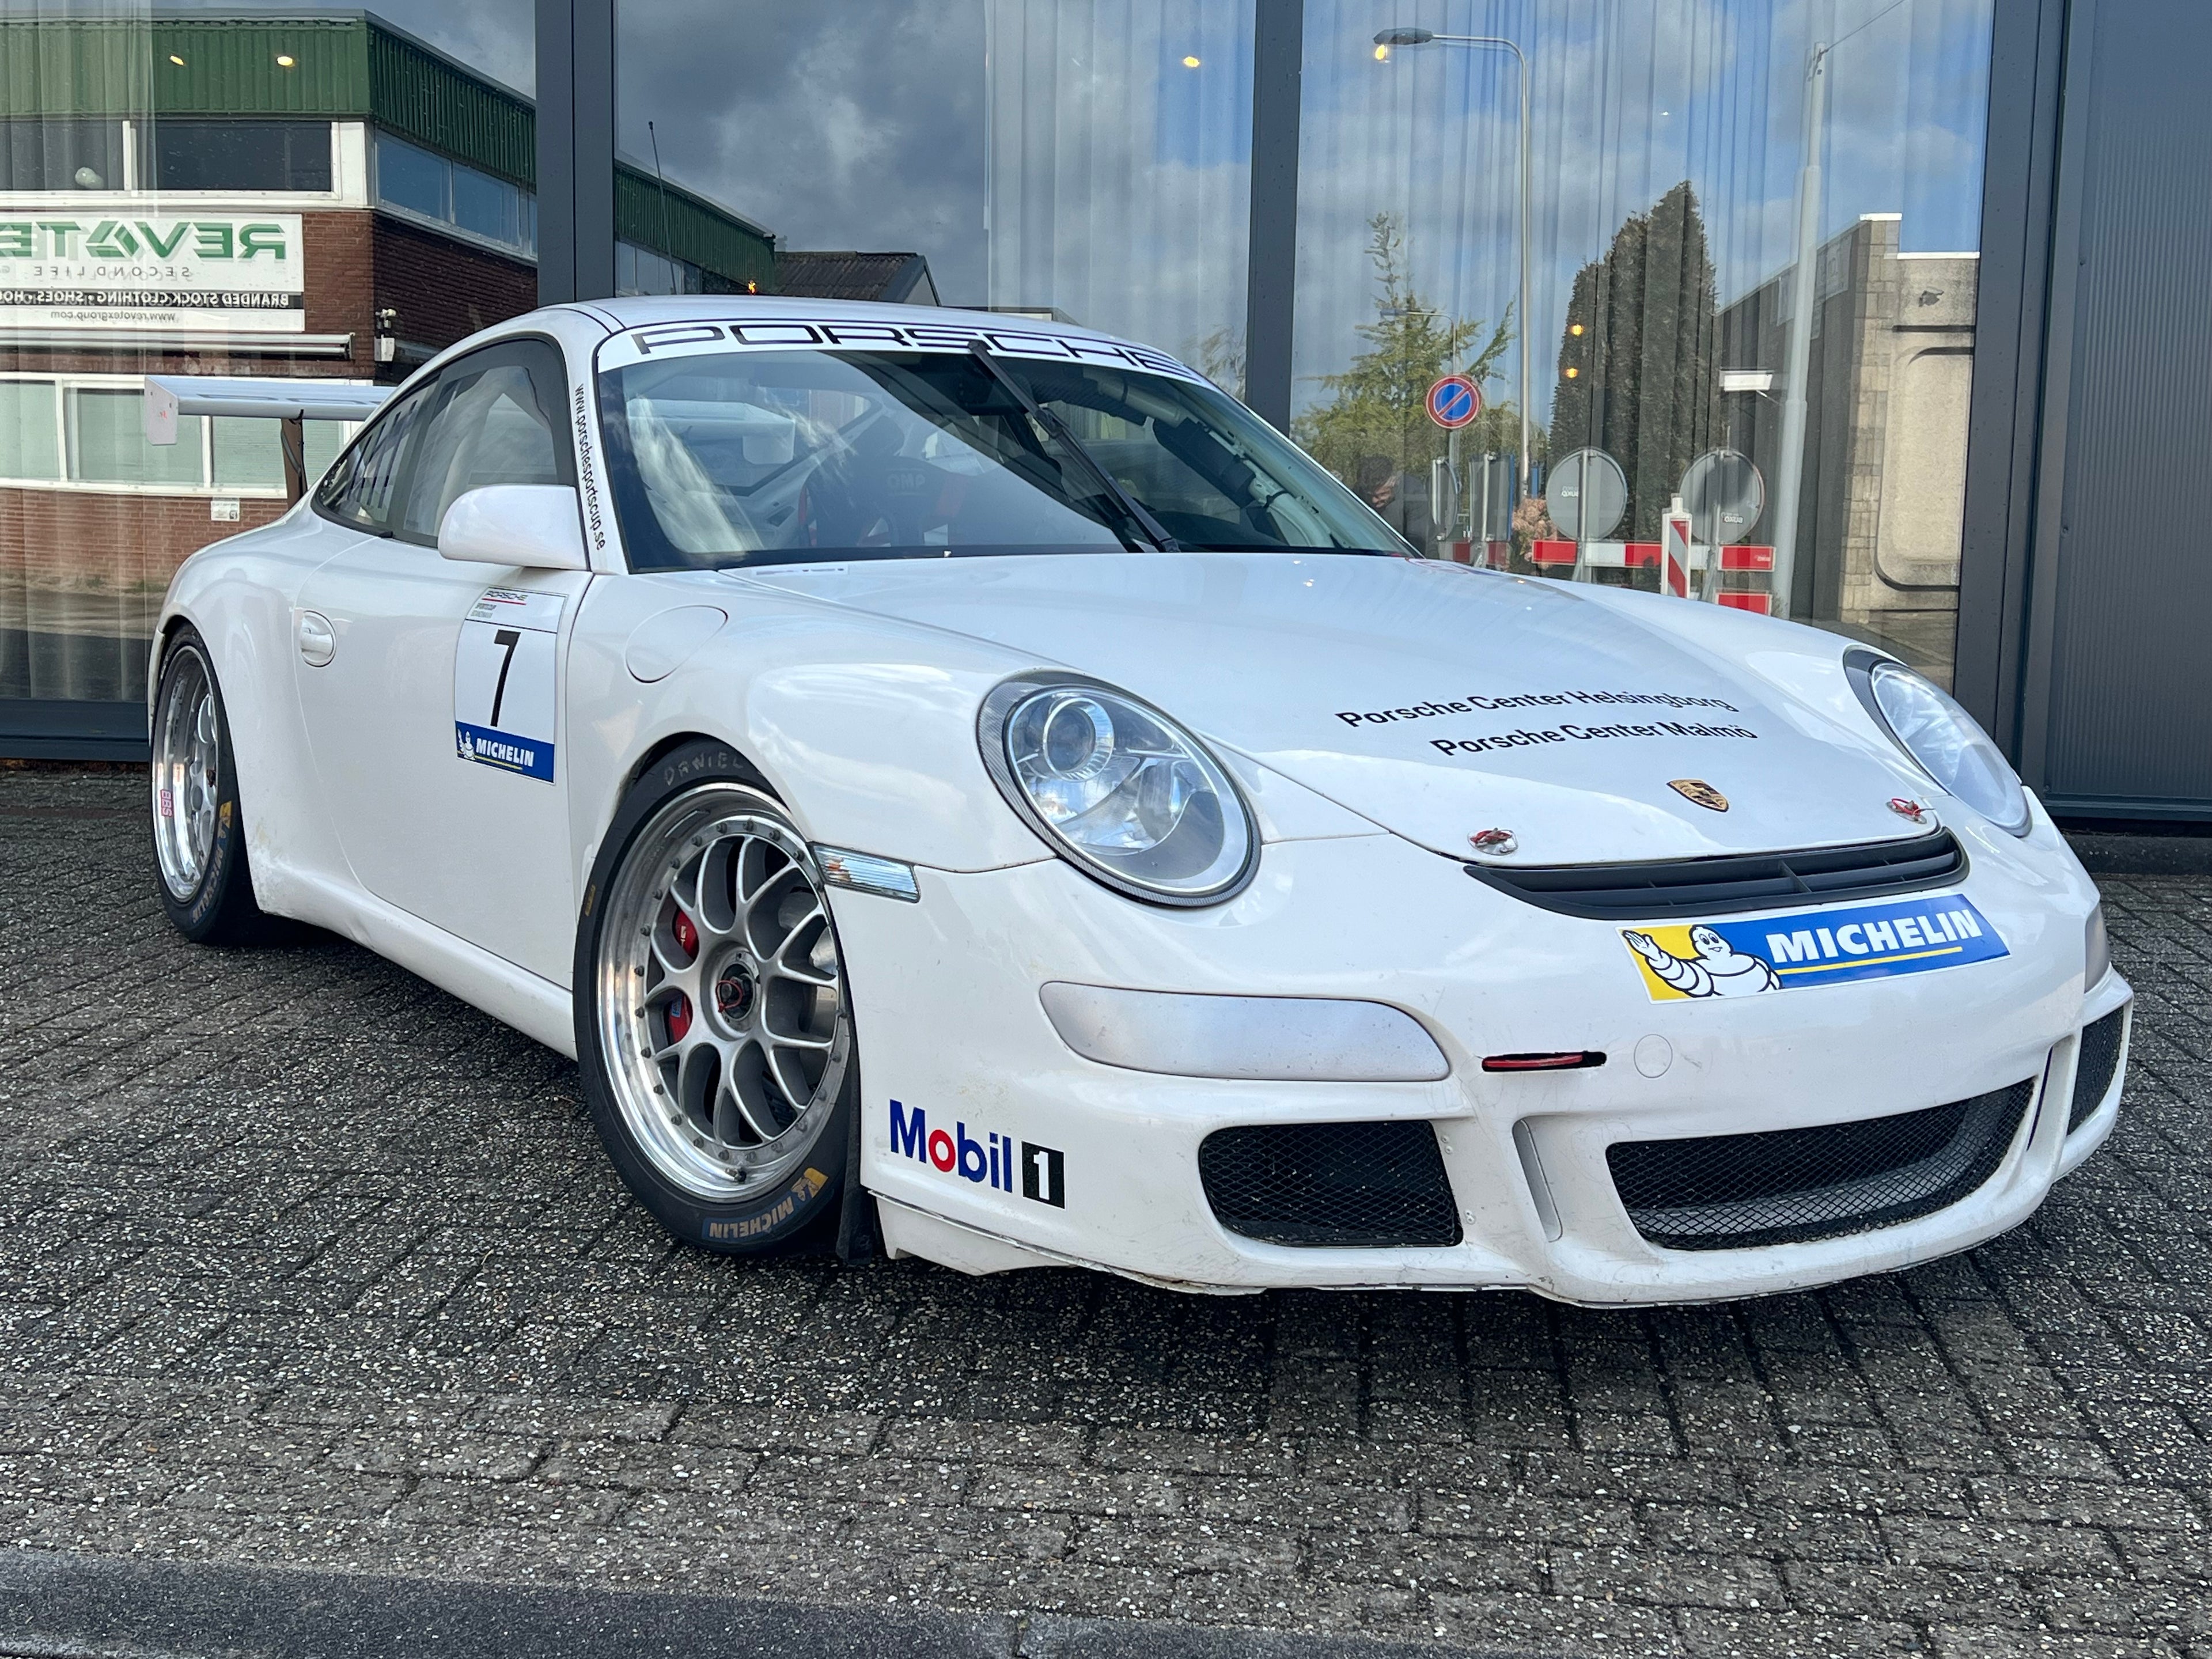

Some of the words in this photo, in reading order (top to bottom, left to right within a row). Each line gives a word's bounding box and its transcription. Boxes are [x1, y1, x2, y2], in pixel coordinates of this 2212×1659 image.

[631, 325, 1202, 382] PORSCHE
[575, 383, 605, 550] www.porschesportscup.se
[491, 628, 521, 728] 7
[1335, 699, 1468, 728] Porsche
[1466, 694, 1568, 710] Center
[1563, 691, 1740, 713] Helsingborg
[475, 737, 535, 768] MICHELIN
[1429, 729, 1566, 756] Porsche
[1559, 724, 1659, 740] Center
[1656, 721, 1759, 739] Malmö
[664, 751, 744, 786] DANIEL
[161, 789, 173, 817] BBS
[1766, 908, 1983, 964] MICHELIN
[889, 1098, 1013, 1194] Mobil
[1033, 1150, 1050, 1200] 1
[709, 1195, 796, 1239] MICHELIN
